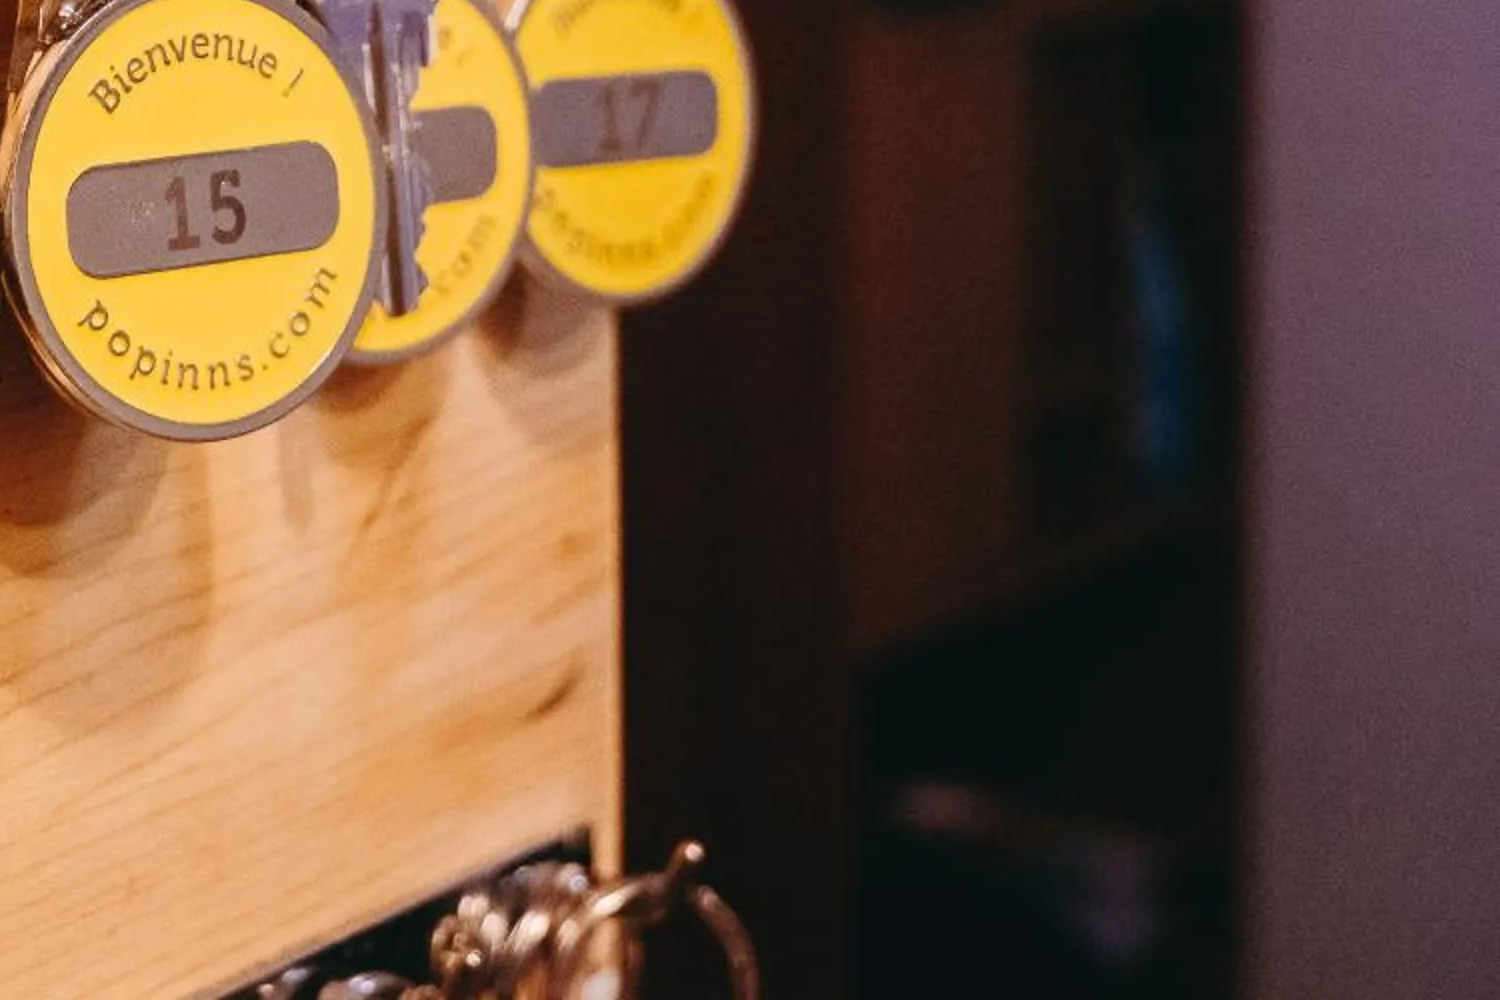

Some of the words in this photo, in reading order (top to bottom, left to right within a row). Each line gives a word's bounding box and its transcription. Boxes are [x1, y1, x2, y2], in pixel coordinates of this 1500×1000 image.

[88, 31, 278, 115] Bienvenue
[281, 67, 304, 98] !
[596, 77, 663, 156] 17
[164, 169, 246, 252] 15
[78, 266, 337, 391] popinns.com
